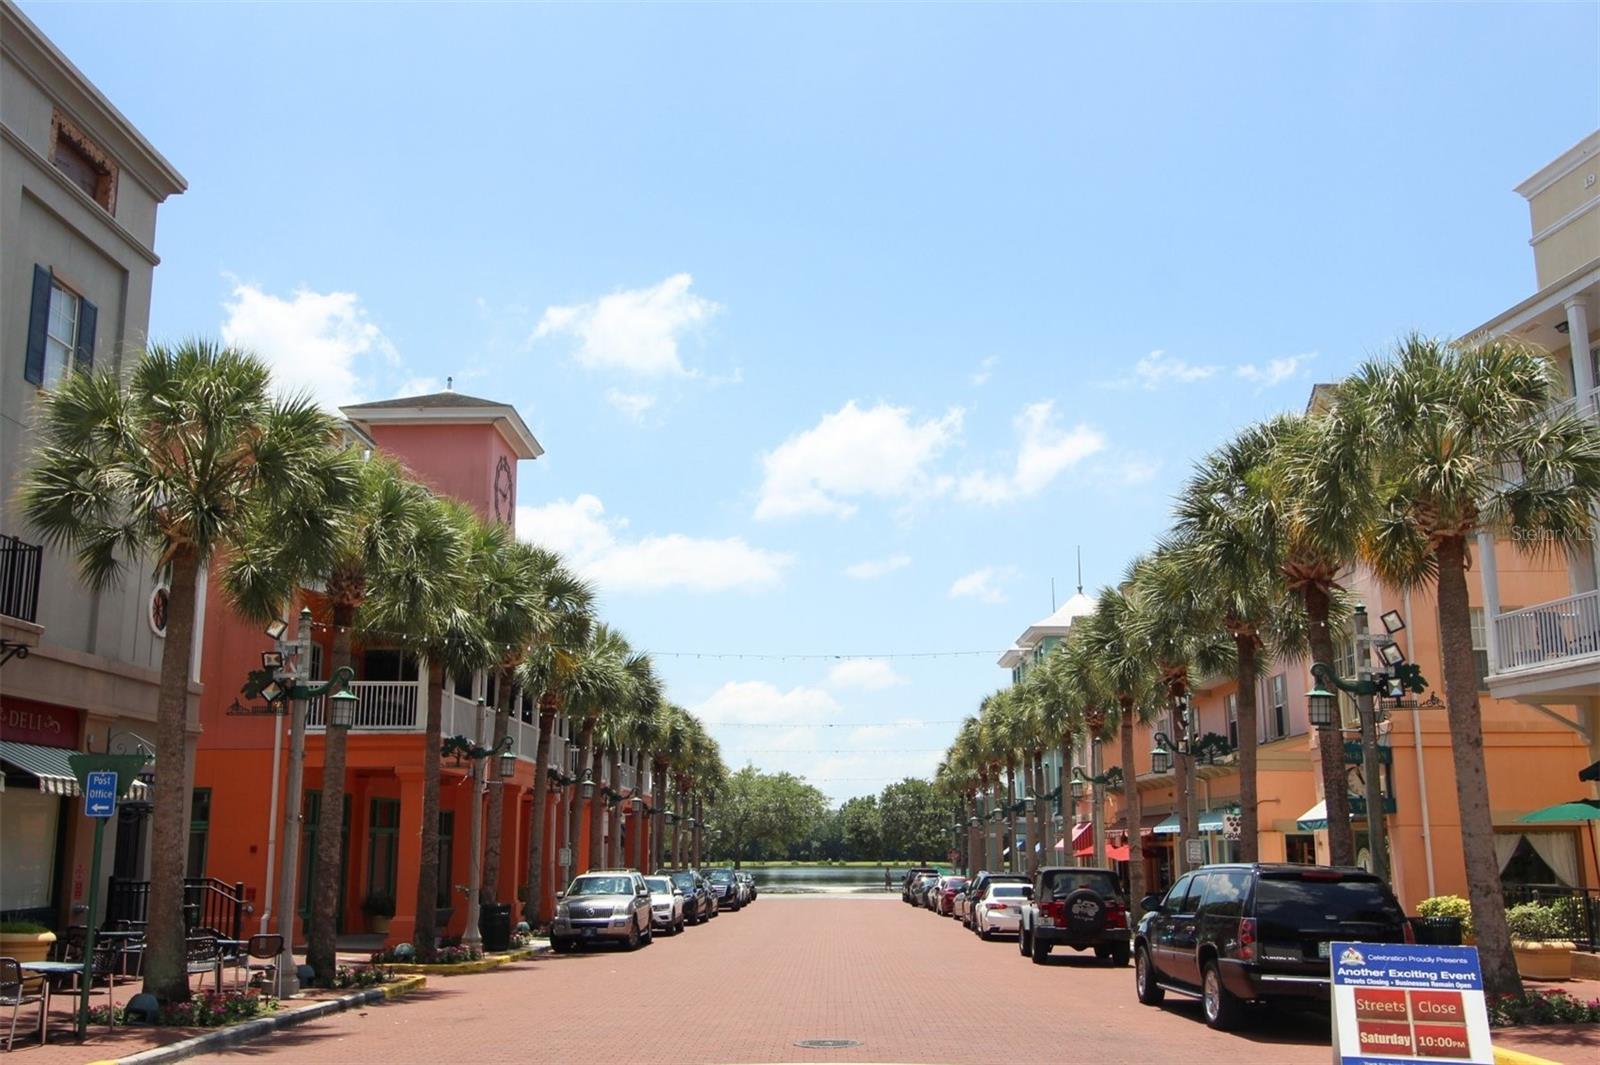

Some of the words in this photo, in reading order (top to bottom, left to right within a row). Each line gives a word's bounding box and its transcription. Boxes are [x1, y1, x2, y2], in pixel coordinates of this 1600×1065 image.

[9, 710, 41, 730] DELI
[93, 776, 110, 785] Post
[89, 789, 113, 799] Office
[1223, 832, 1241, 840] GRA
[1367, 953, 1408, 962] Celebration
[1408, 955, 1435, 964] Proudly
[1337, 967, 1385, 977] Another
[1388, 969, 1438, 980] Exciting
[1440, 971, 1477, 981] Event
[1343, 977, 1366, 985] Streets
[1366, 978, 1390, 987] Closing
[1356, 998, 1406, 1013] Streets
[1418, 1001, 1457, 1014] Close
[1360, 1032, 1411, 1046] Saturday
